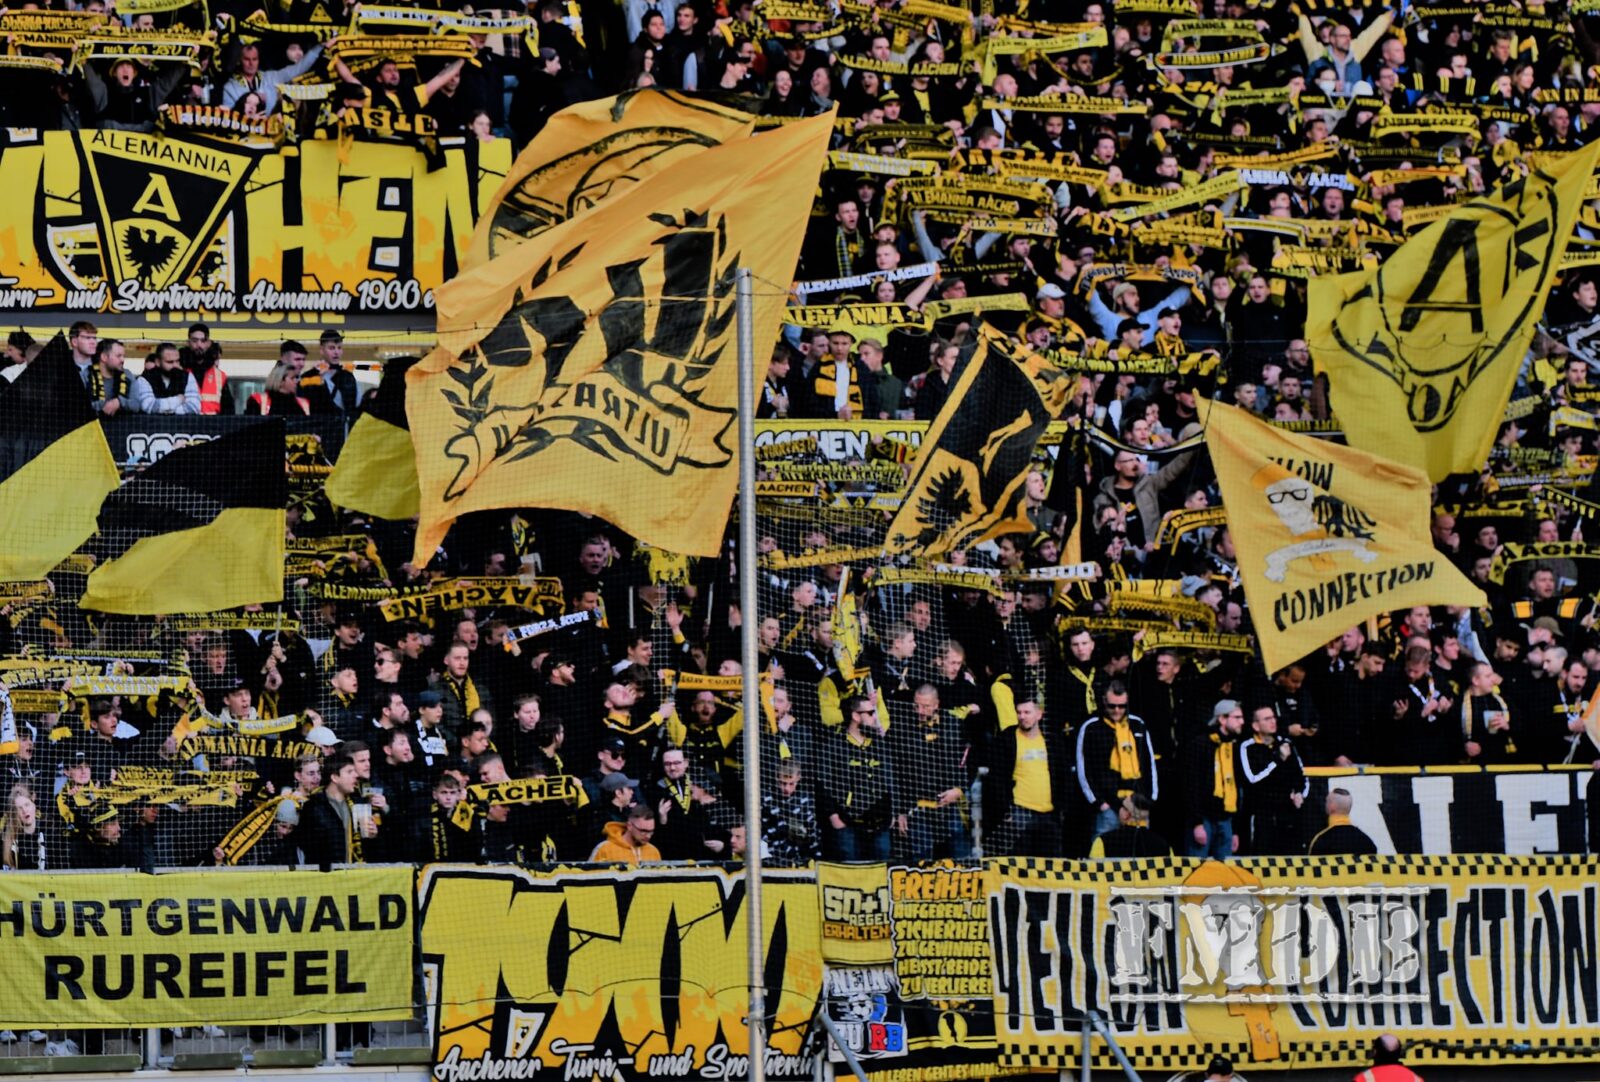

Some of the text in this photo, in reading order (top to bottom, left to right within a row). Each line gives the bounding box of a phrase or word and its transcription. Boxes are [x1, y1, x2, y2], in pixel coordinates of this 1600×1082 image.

[841, 55, 959, 76] ALEMANNIA AACHEN
[92, 131, 232, 176] ALEMANNIA
[132, 172, 181, 222] A
[977, 196, 1019, 214] AACHE
[0, 277, 54, 308] urn-
[67, 288, 107, 309] und
[242, 279, 350, 311] Alemannia
[356, 280, 420, 310] 1900
[797, 275, 871, 296] ALEMANNIA
[782, 306, 905, 326] ALEMANNIA
[757, 483, 812, 494] AACHEN
[1274, 561, 1435, 633] CONNECTION
[242, 611, 288, 619] AACHEN
[92, 683, 157, 694] AACHEN
[466, 777, 579, 804] AACHEN
[1327, 772, 1594, 857] ALE
[224, 807, 273, 858] LEMANNIA
[0, 892, 407, 938] HÜRTGENWALD
[850, 913, 890, 926] REGEL
[824, 924, 890, 939] ERHALTEN
[44, 949, 367, 1001] RUREIFEL
[901, 977, 921, 996] ZU
[433, 1038, 817, 1082] Aachener Turn- und Spotverein
